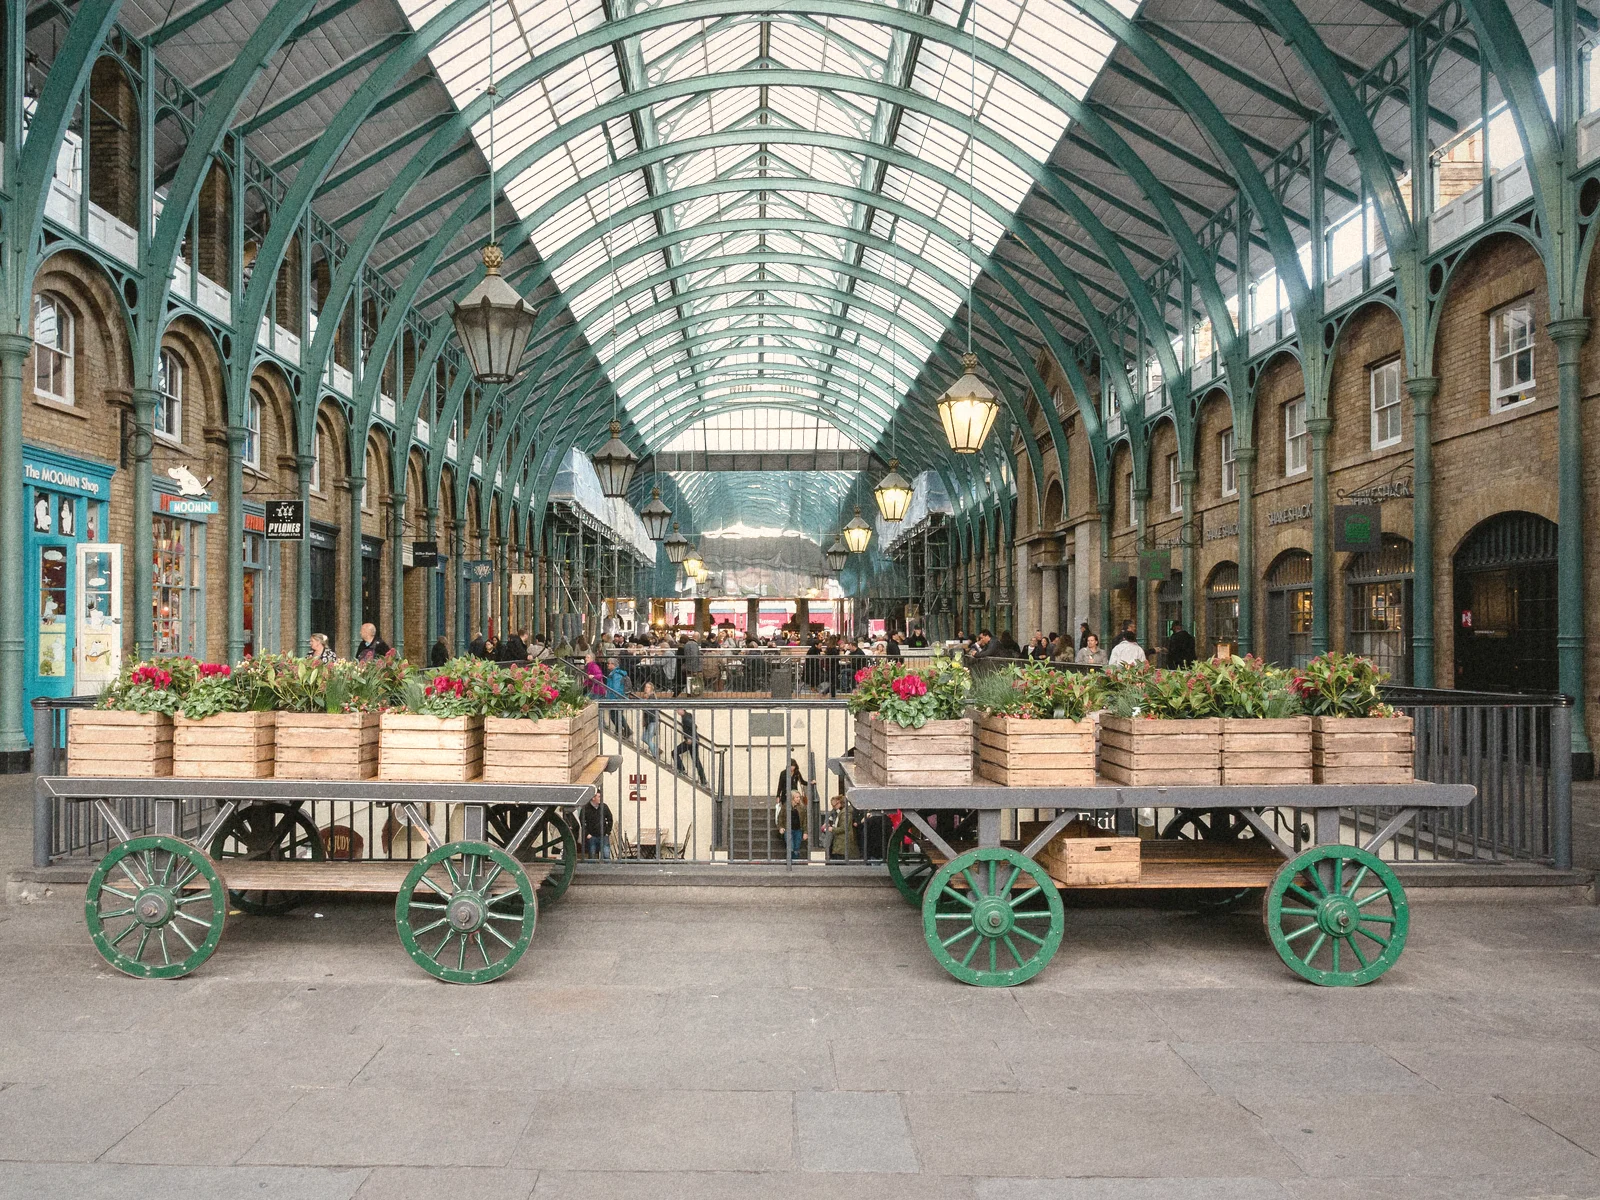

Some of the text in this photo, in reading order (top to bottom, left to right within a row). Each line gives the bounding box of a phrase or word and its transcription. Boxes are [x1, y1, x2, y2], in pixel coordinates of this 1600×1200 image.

[25, 464, 99, 495] The MOOMIN Shop
[173, 502, 212, 513] MOOMIN
[268, 523, 301, 533] PYLONES
[333, 835, 351, 853] JUDY
